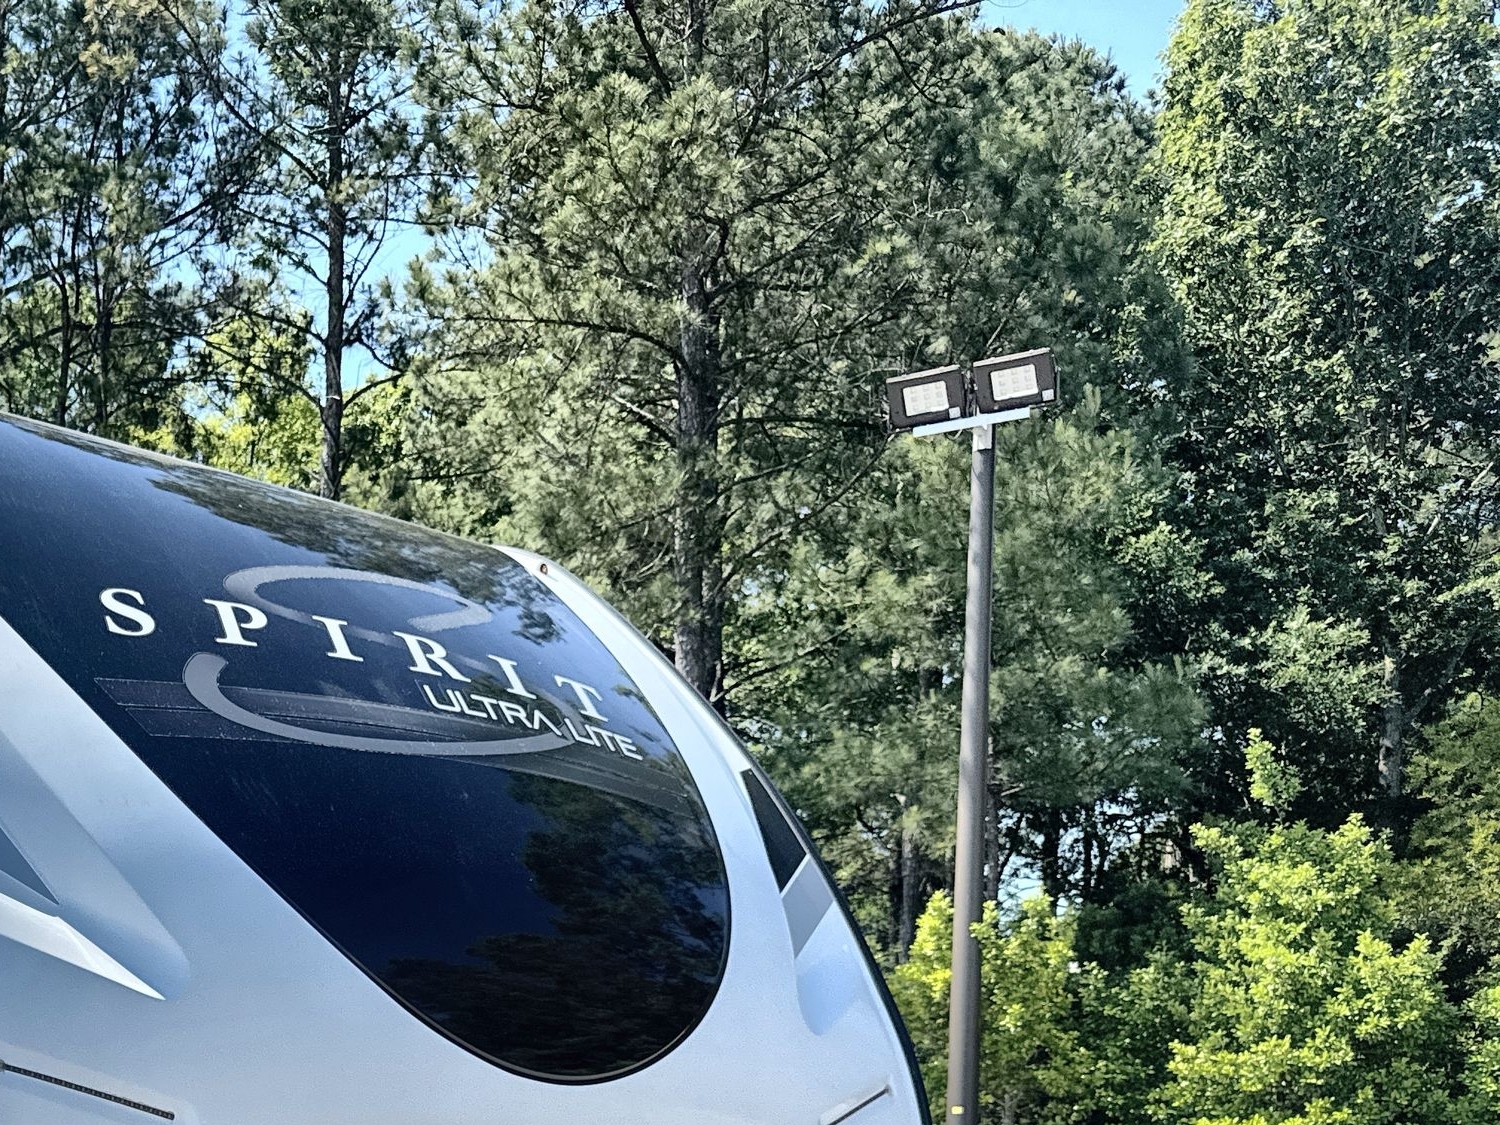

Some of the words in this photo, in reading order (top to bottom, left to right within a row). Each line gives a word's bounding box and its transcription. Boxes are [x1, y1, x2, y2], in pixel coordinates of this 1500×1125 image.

[99, 587, 609, 722] SPIRIT
[423, 684, 562, 736] ULTRA
[564, 717, 643, 761] LITE
